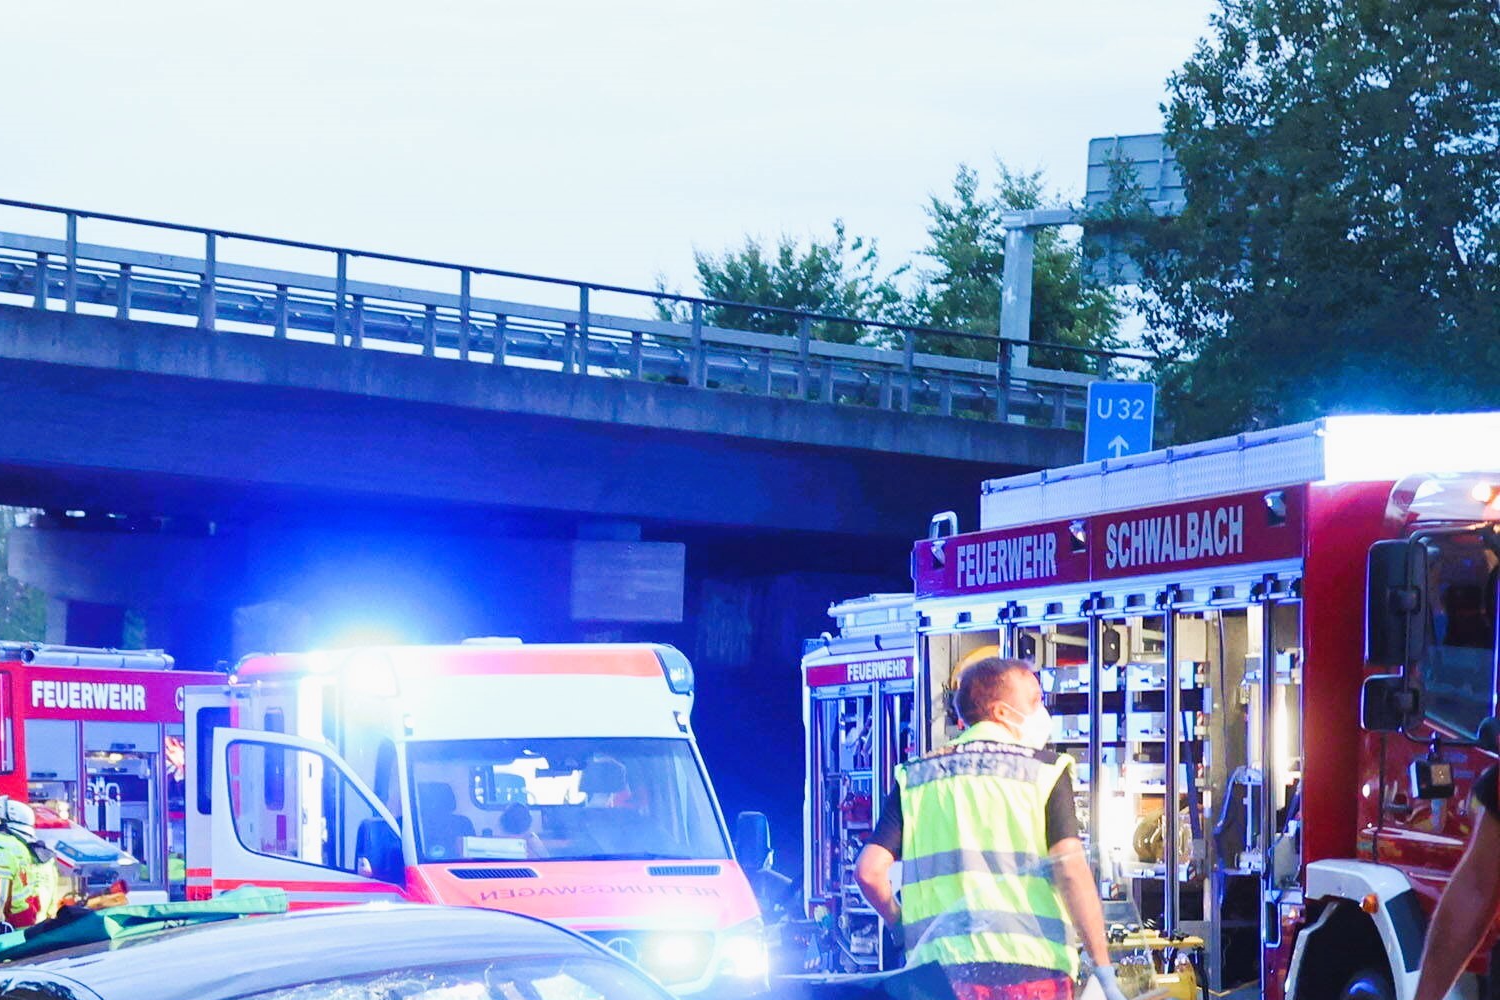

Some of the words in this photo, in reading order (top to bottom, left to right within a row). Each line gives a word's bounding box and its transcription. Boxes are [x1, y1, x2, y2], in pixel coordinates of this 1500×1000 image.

[1097, 397, 1113, 419] U
[1117, 398, 1145, 420] 32
[957, 532, 1058, 588] FEUERWEHR
[1106, 505, 1244, 570] SCHWALBACH
[847, 659, 908, 682] FEUERWEHR
[31, 680, 146, 711] FEUERWEHR
